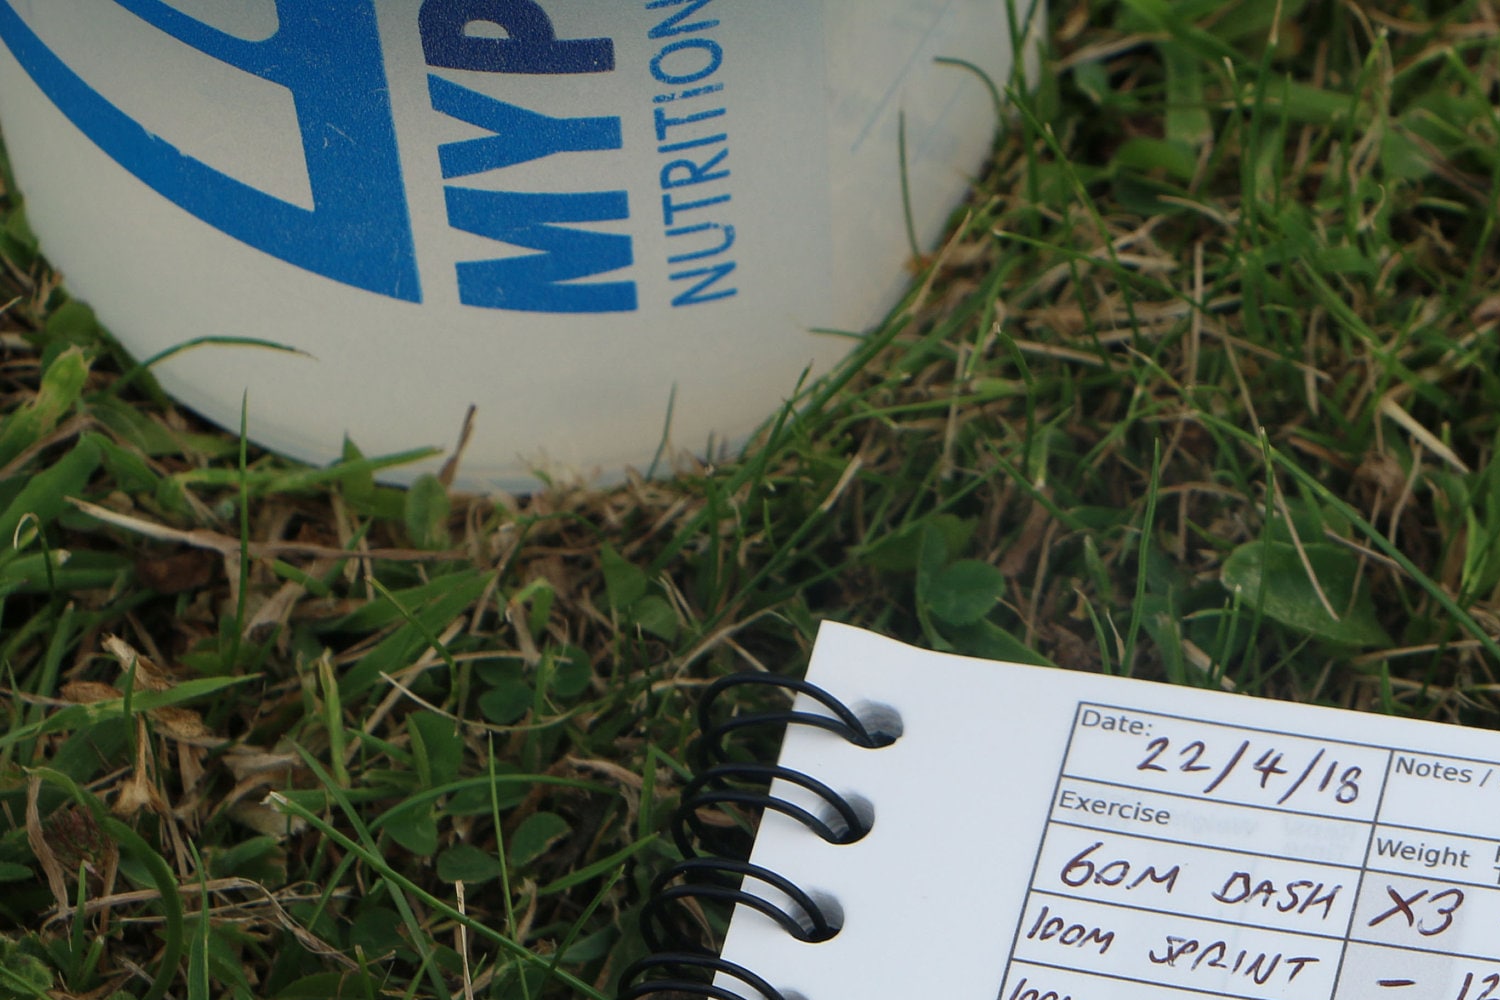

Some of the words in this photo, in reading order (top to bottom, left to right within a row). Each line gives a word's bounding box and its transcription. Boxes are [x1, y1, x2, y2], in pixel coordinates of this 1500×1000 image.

[1080, 709, 1153, 737] Date:
[1137, 737, 1363, 804] 22/4/18
[1394, 756, 1473, 786] Notes
[1058, 790, 1171, 827] Exercise
[1375, 838, 1470, 870] Weight
[1060, 842, 1180, 894] 60M
[1212, 871, 1343, 920] DASH
[1026, 906, 1114, 954] 100M
[1150, 936, 1319, 985] SPRINT
